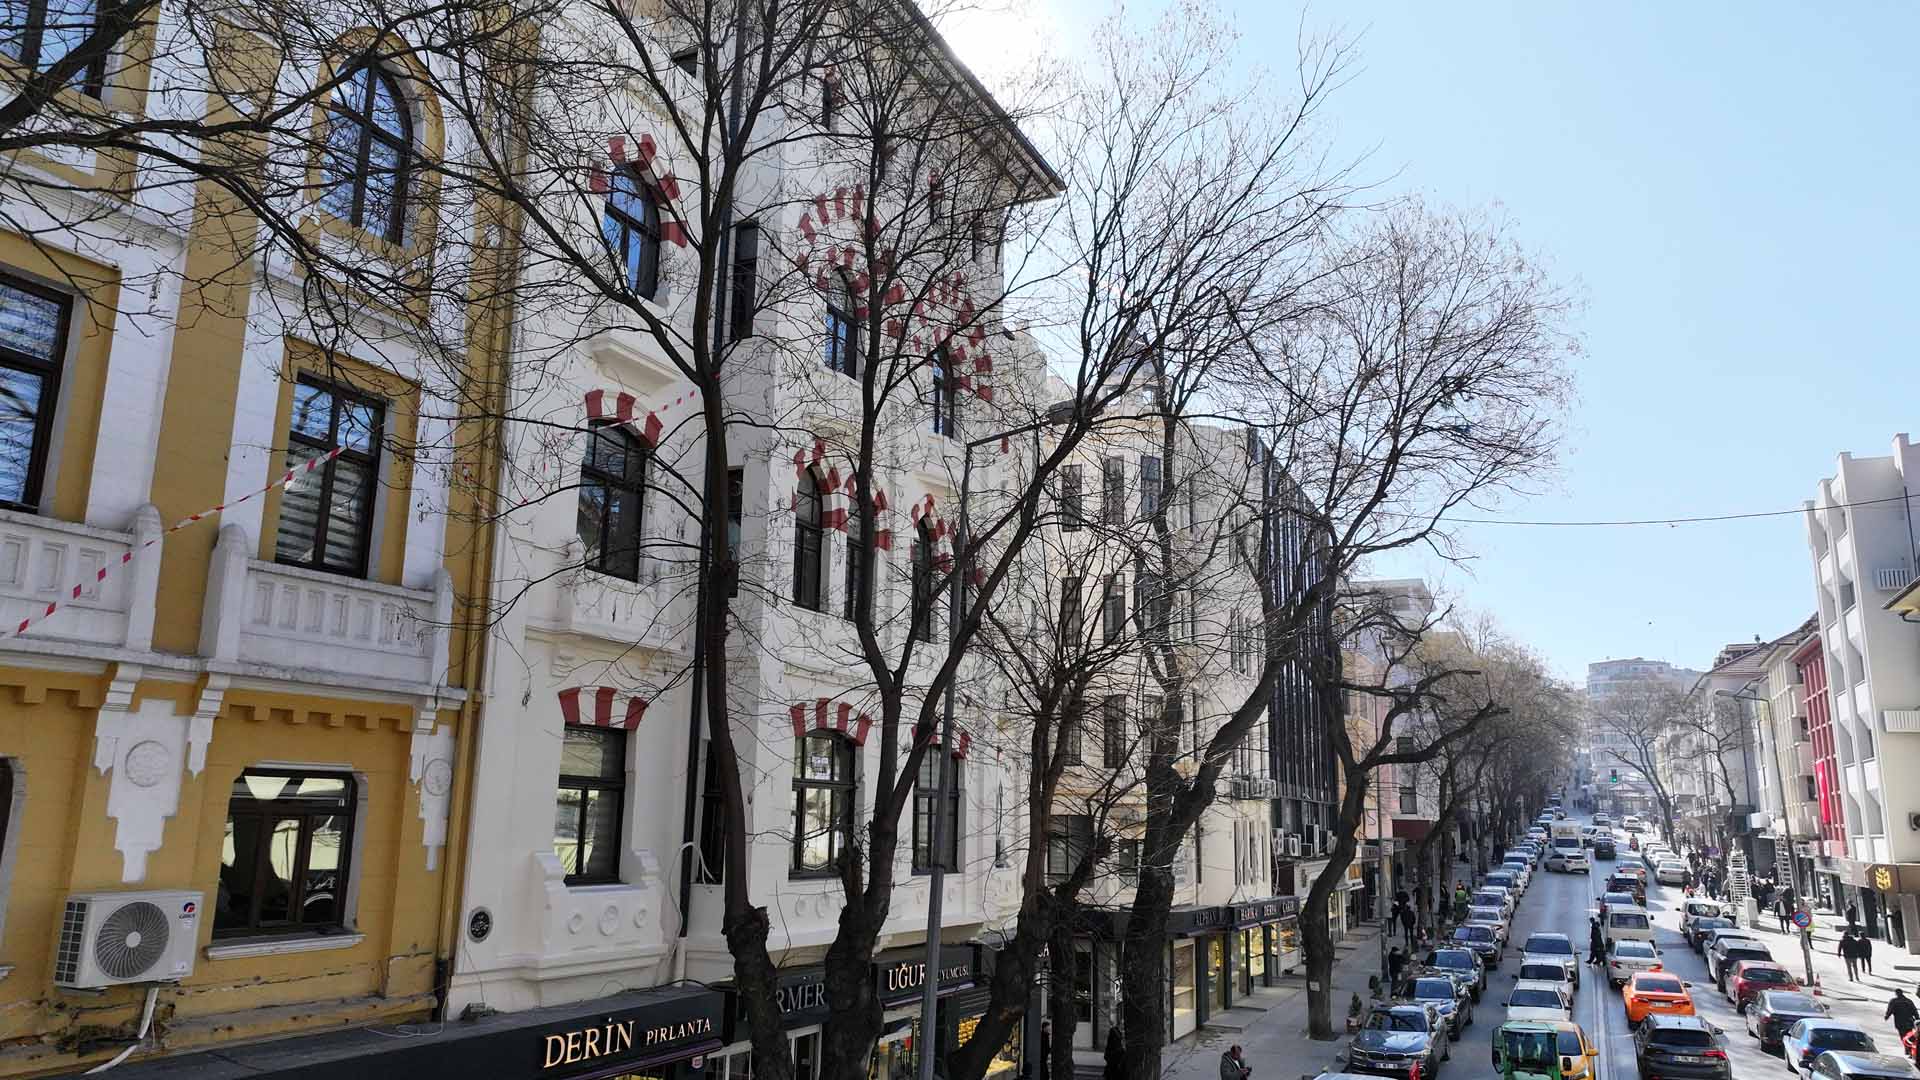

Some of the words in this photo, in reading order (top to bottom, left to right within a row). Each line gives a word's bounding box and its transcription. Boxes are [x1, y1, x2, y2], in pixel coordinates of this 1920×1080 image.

[775, 982, 825, 1014] RMER
[543, 1016, 635, 1069] DERİN
[646, 1017, 712, 1046] PIRLANTA
